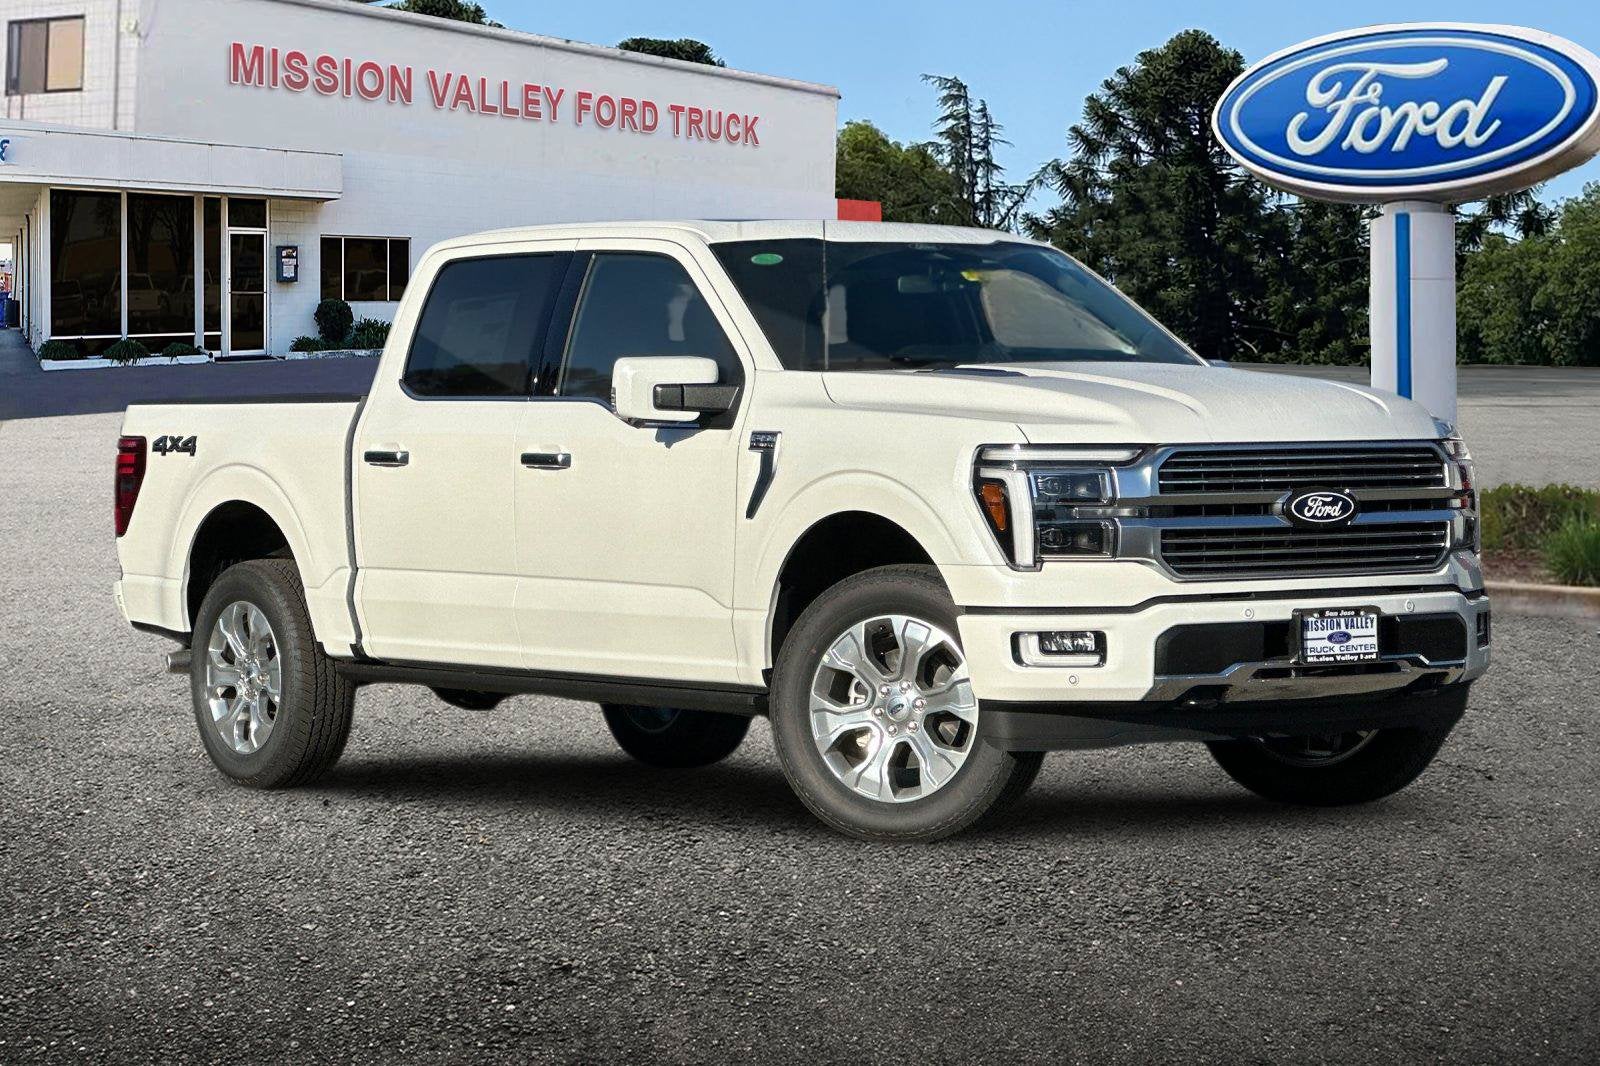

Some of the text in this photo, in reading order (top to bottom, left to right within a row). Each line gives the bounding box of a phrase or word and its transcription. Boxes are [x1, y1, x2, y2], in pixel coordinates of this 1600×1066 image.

[230, 41, 761, 146] MISSION VALLEY FORD TRUCK
[1286, 57, 1509, 156] Ford
[1304, 496, 1342, 517] Ford
[1304, 616, 1375, 631] MISSION VALLEY
[1304, 644, 1376, 655] TRUCK CENTER
